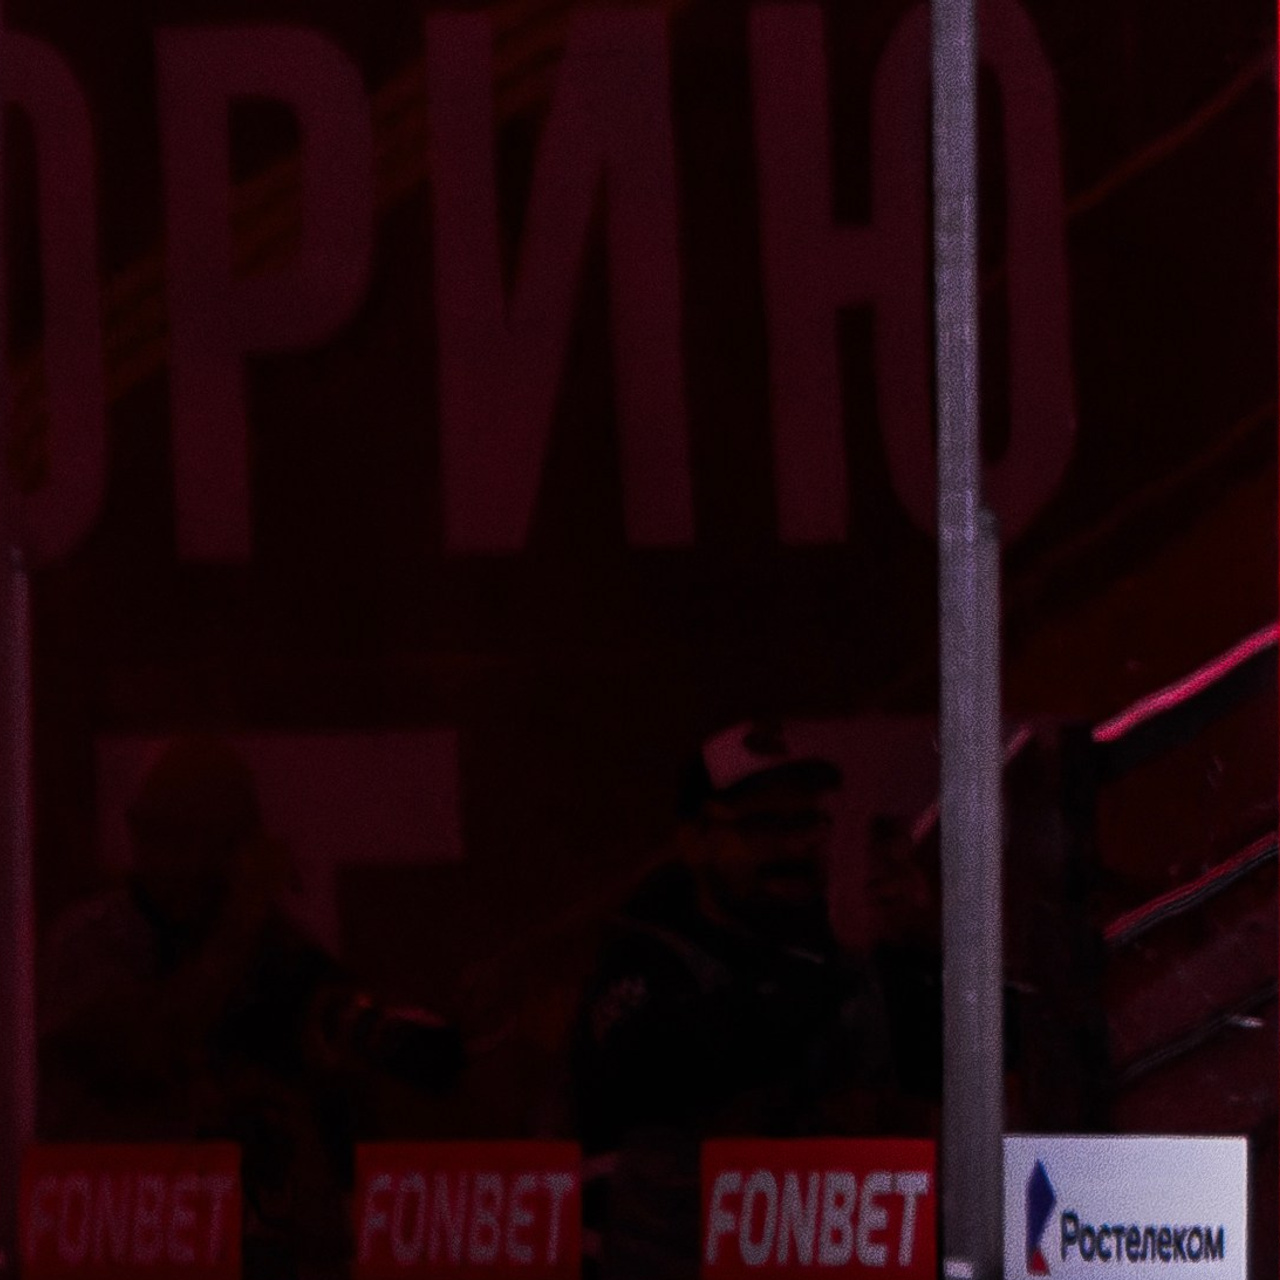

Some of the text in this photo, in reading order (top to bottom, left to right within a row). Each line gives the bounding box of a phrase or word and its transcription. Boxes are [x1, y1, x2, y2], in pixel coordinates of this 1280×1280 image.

[25, 1171, 236, 1267] FONBET
[358, 1171, 579, 1267] FONBET
[704, 1169, 931, 1268] FONBET
[1060, 1210, 1224, 1263] Ростелеком
